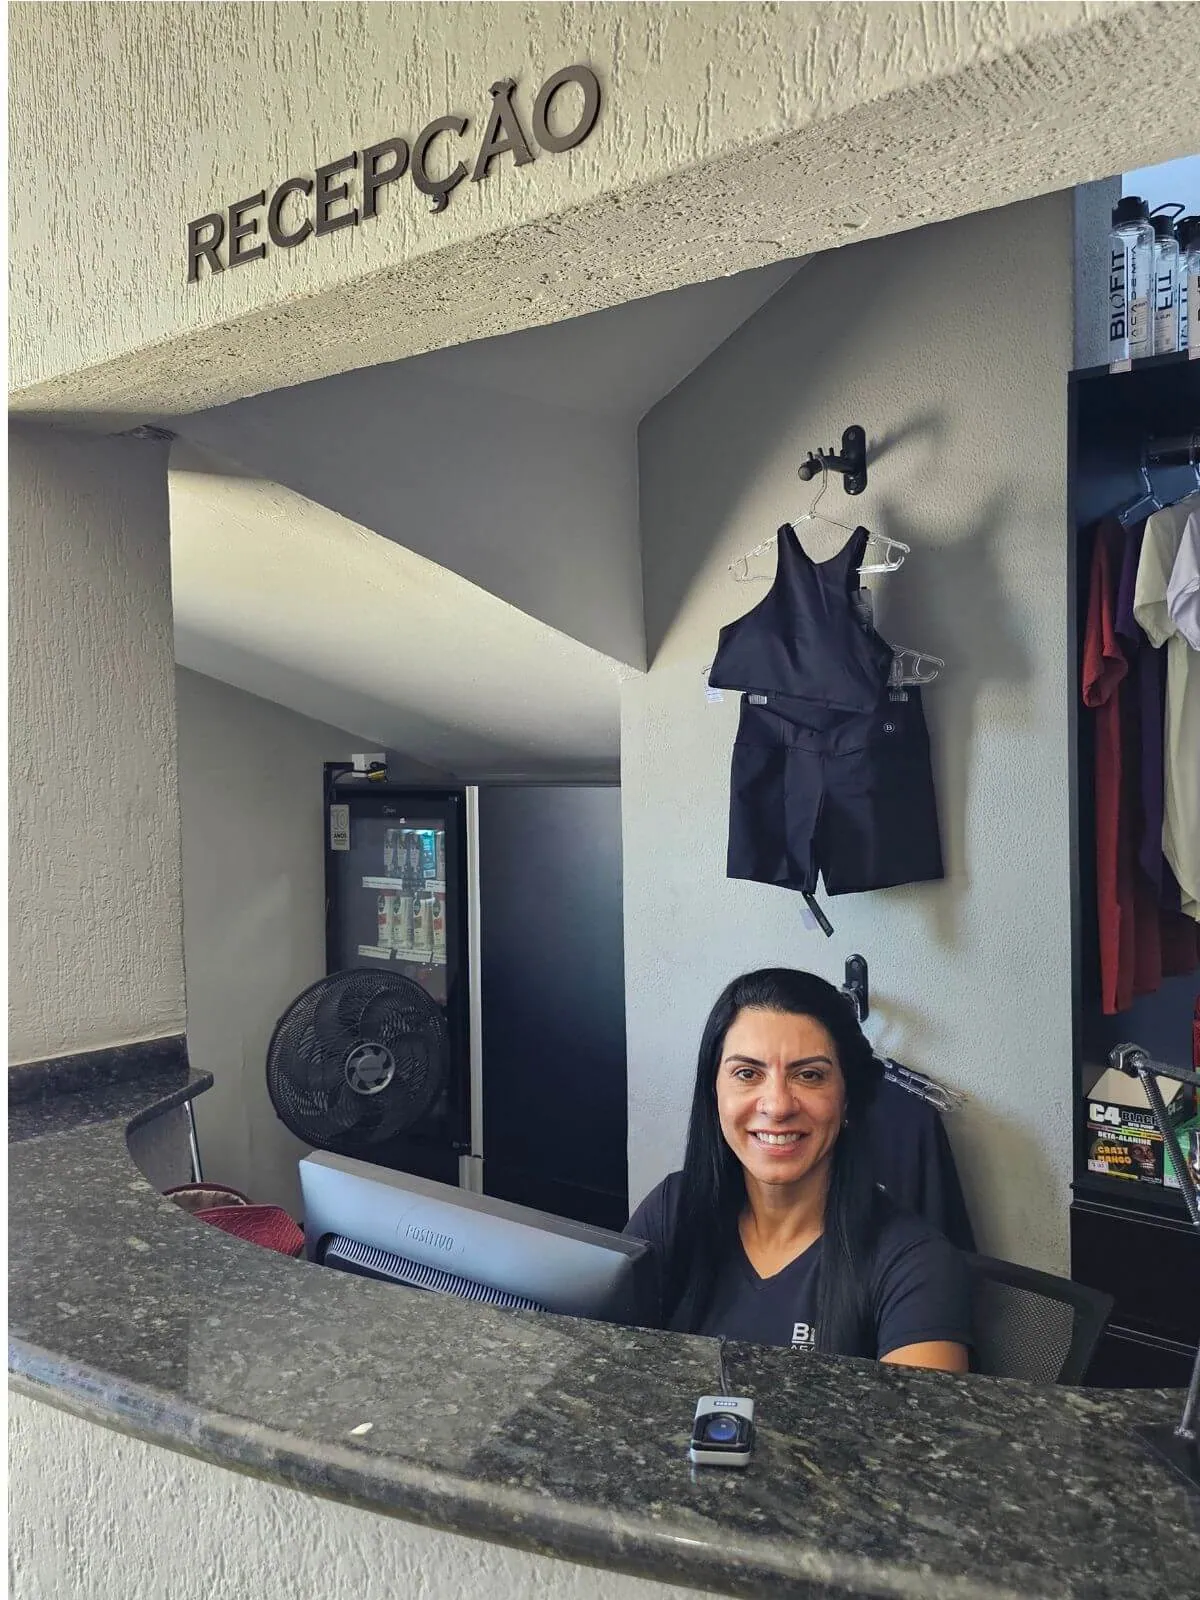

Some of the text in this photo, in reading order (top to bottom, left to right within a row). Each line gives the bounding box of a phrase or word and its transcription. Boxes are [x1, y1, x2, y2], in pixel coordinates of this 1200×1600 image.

[187, 65, 602, 284] RECEPÇÃO
[1089, 1103, 1121, 1126] C4
[1097, 1146, 1129, 1155] CRAZY
[1097, 1155, 1132, 1165] MANGO
[405, 1223, 455, 1252] POSITIVO
